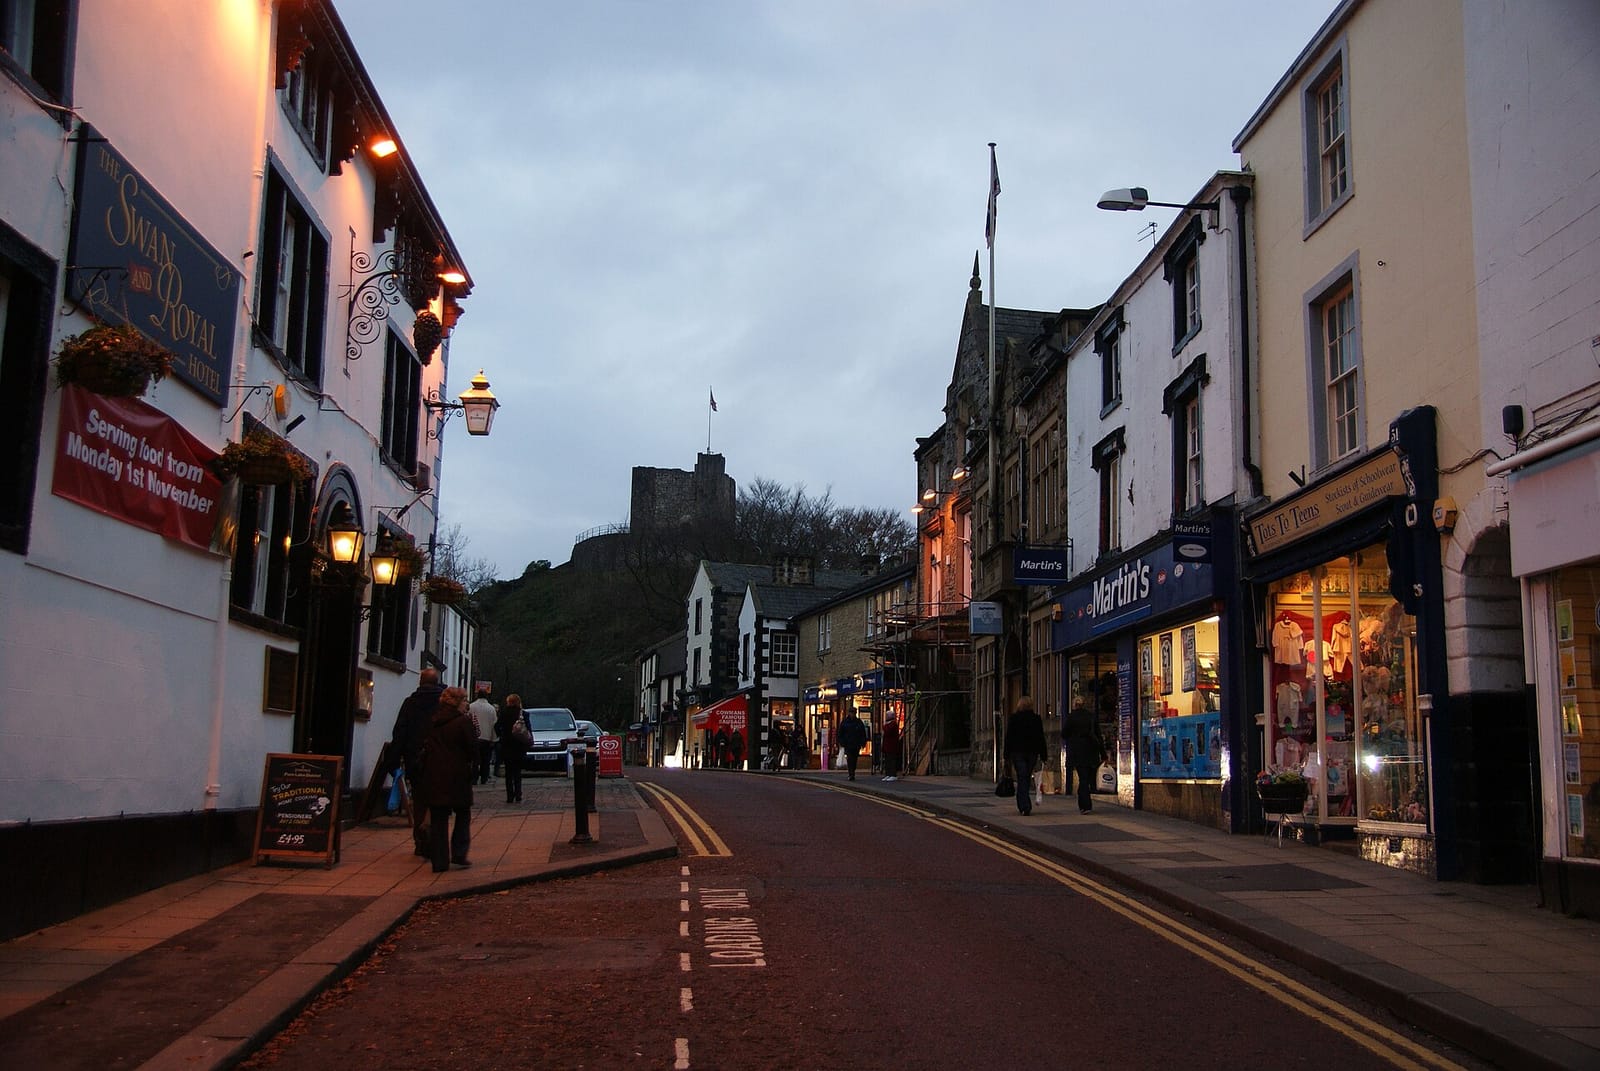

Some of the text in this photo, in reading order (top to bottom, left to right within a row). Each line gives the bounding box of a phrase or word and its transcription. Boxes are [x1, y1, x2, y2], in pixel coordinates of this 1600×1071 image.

[99, 149, 121, 184] THE
[131, 270, 152, 290] AND
[188, 353, 221, 394] HOTEL
[86, 408, 204, 484] Serving food from
[66, 432, 214, 515] Monday 1st November
[1359, 463, 1396, 488] Schoolwear
[1174, 524, 1211, 534] Martin's
[1254, 522, 1277, 545] Tots
[1274, 512, 1290, 536] To
[1288, 503, 1320, 529] Teens
[1020, 559, 1063, 571] Martin's
[1091, 558, 1151, 619] Martin's
[271, 787, 327, 801] TRADITIONAL
